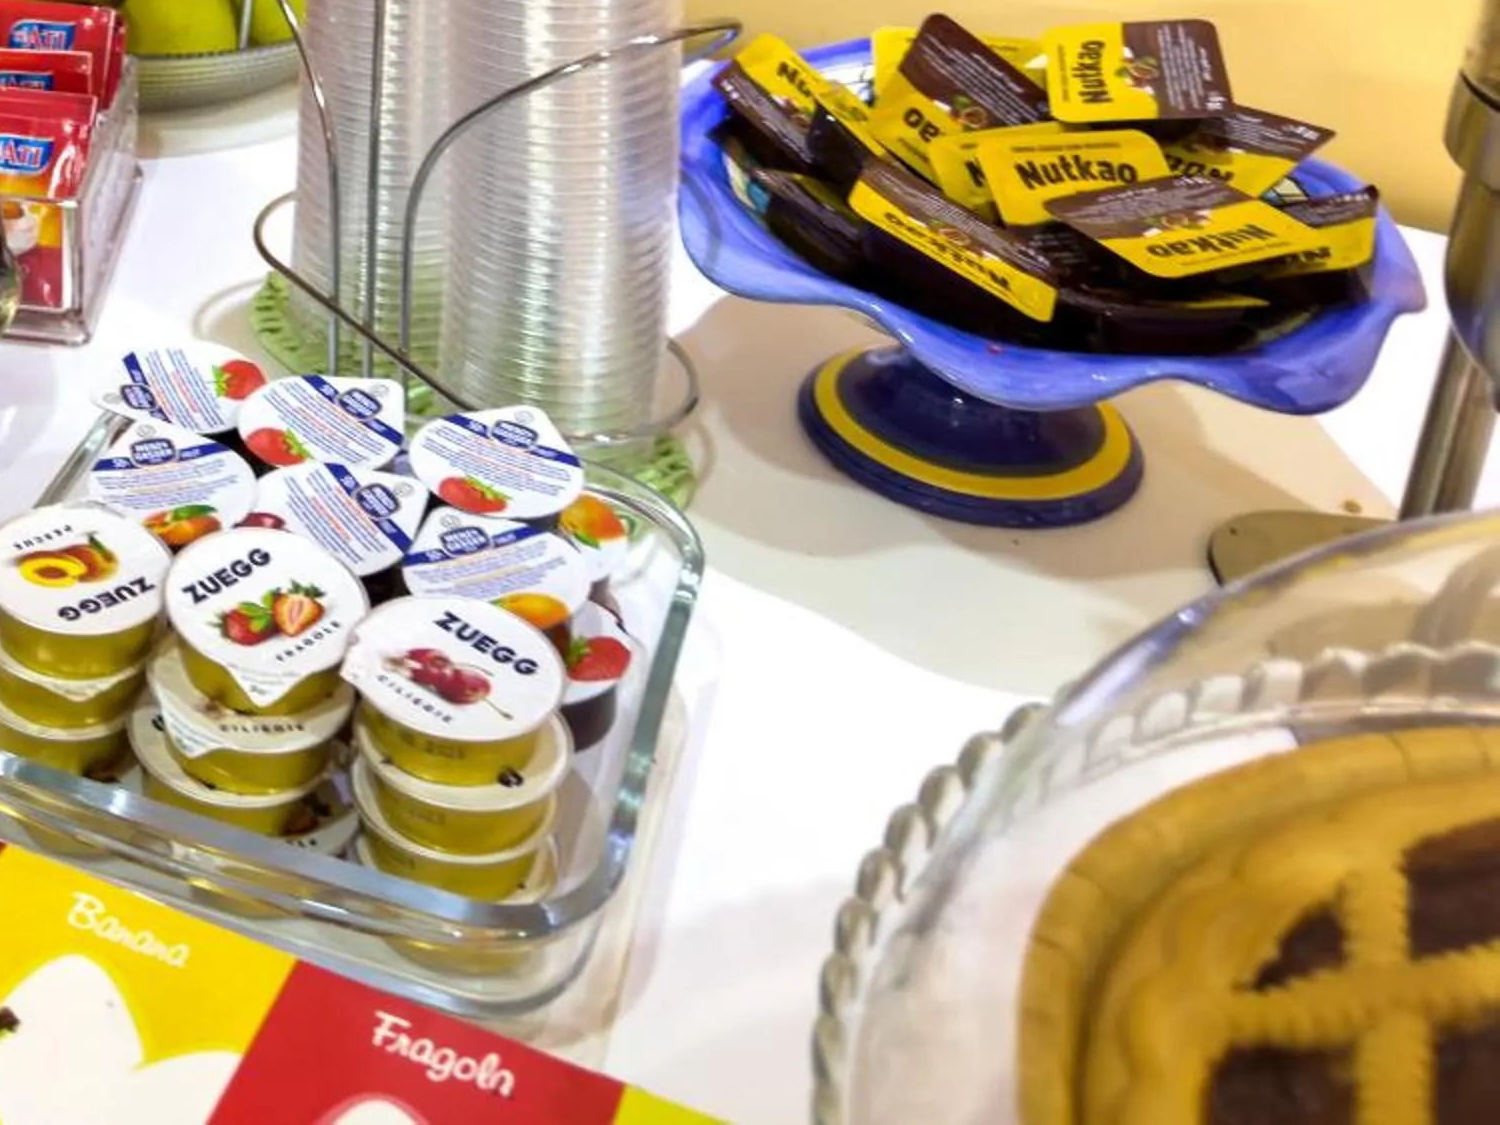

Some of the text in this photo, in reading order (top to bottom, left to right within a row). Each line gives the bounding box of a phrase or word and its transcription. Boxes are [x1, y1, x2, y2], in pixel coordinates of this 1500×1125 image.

[1072, 41, 1113, 104] Nutkao
[1013, 154, 1138, 190] Nutkao
[1146, 223, 1277, 258] Nutkao
[57, 576, 157, 622] ZUEGG
[181, 547, 272, 604] ZUEGG
[433, 610, 539, 676] ZUEGG
[65, 892, 192, 968] Banana
